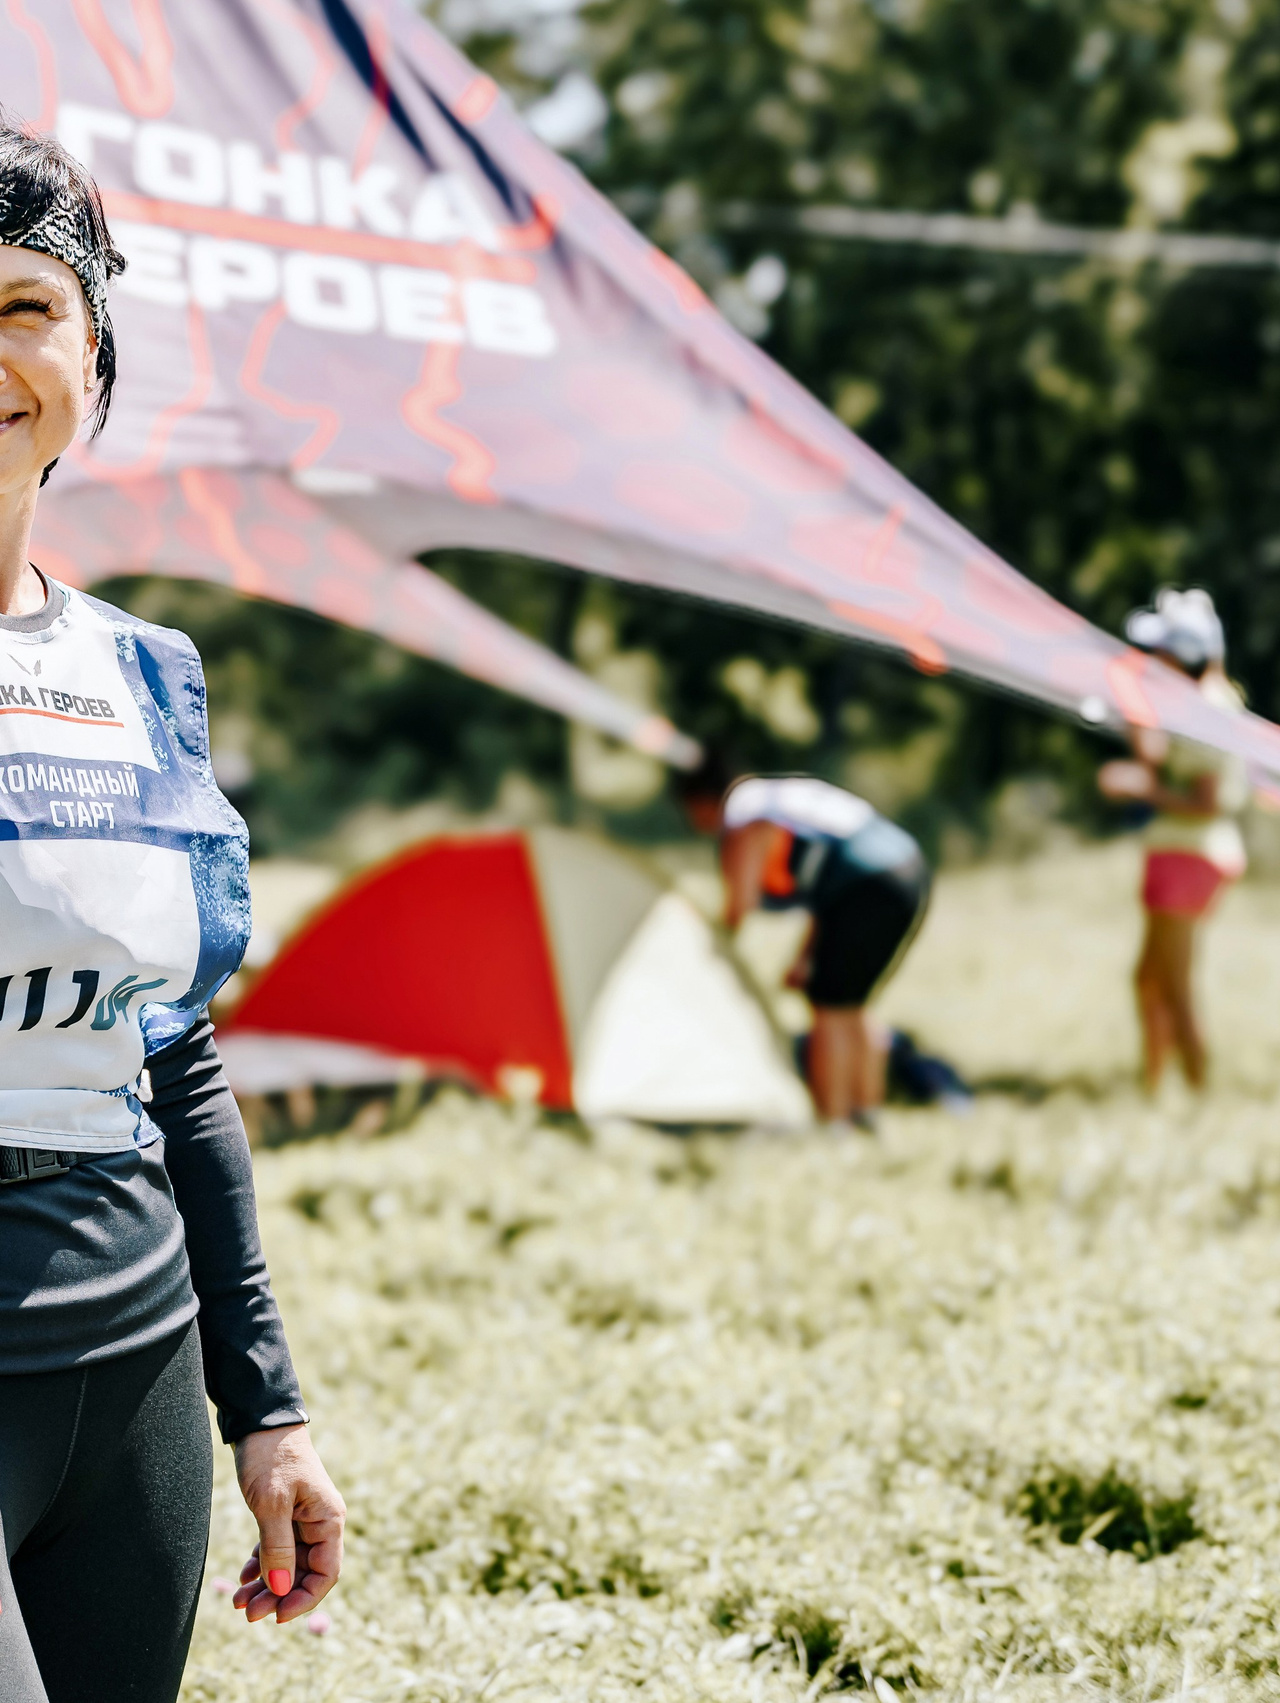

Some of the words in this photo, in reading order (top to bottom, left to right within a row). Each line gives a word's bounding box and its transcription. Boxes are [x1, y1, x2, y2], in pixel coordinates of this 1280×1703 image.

[57, 102, 500, 252] ГОНКА
[113, 220, 558, 358] ЕРОЕВ
[38, 686, 116, 719] ГЕРОЕВ
[49, 800, 115, 830] СТАРТ
